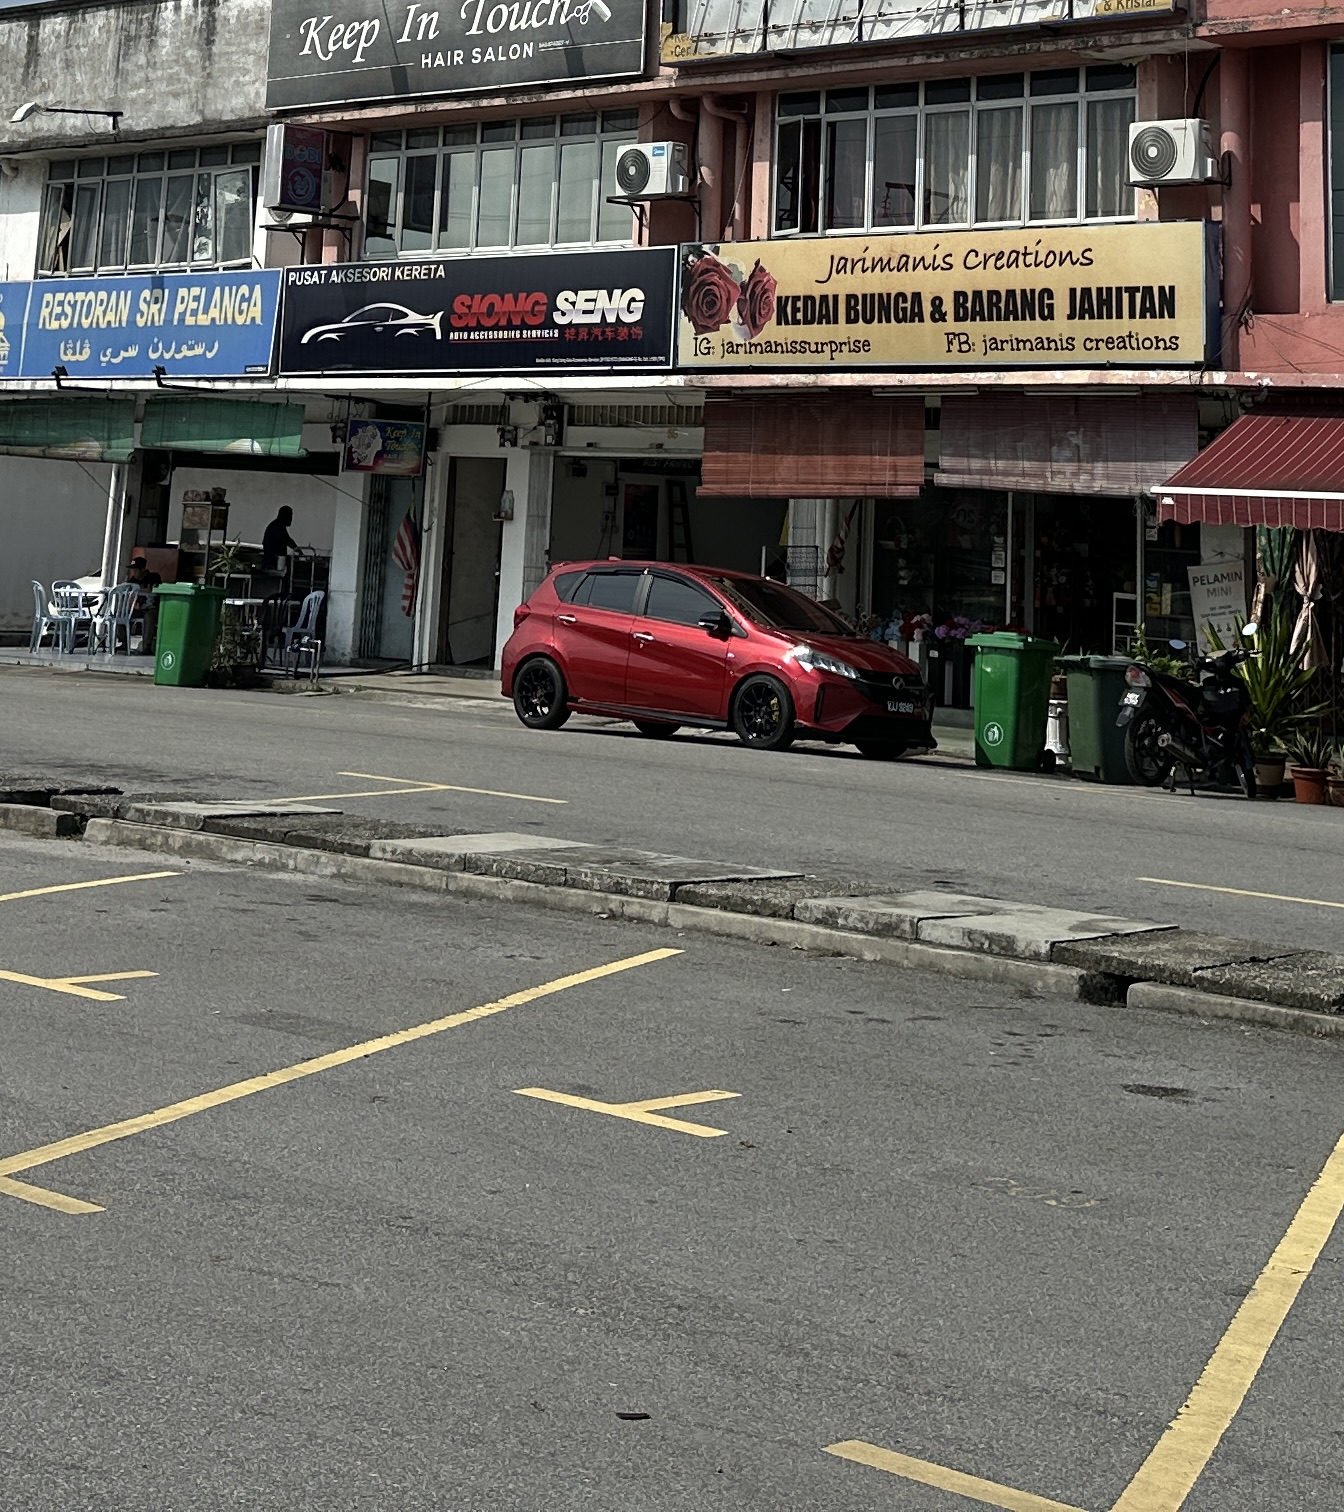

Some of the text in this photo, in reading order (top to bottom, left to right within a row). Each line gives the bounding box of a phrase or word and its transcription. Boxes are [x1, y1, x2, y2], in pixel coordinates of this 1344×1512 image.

[298, 14, 381, 64] Keep
[397, 3, 440, 45] In
[421, 49, 464, 68] HAIR
[471, 42, 535, 65] SALON
[815, 239, 1095, 284] Jarimanis Creations
[288, 264, 446, 286] PUSAT AKSESORI KERETA
[38, 284, 263, 330] RESTORAN SRI PELANGA
[450, 287, 646, 328] SIONG SENG
[776, 285, 1176, 326] KEDAI BUNGA & BARANG JAHITAN
[449, 328, 559, 340] AUTO ACCESSORIES SERVICES
[944, 330, 1180, 356] FB: jarimanis creations
[693, 336, 871, 361] IG: jarimanissurprise
[1192, 570, 1243, 587] PELAMIN
[1206, 586, 1232, 598] MINI
